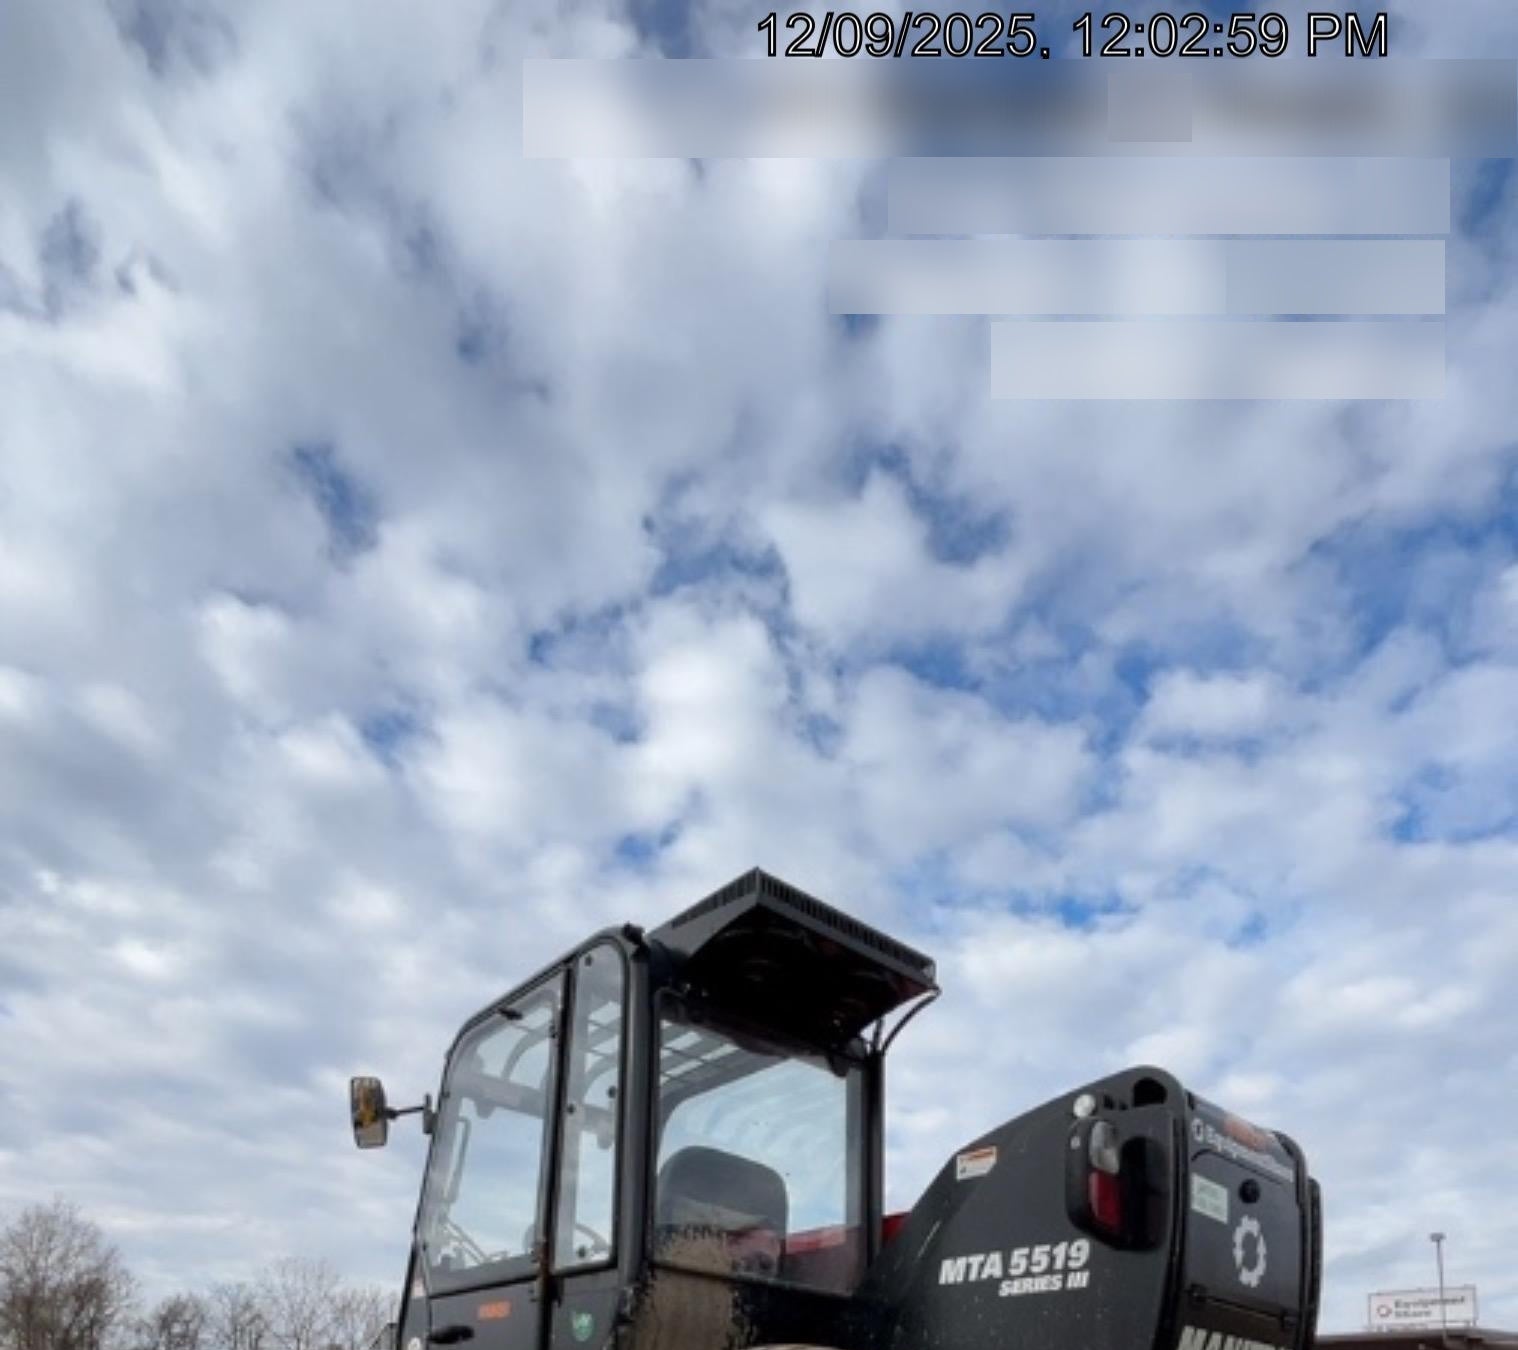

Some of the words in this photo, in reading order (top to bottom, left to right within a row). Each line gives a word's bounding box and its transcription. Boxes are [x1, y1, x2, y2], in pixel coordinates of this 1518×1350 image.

[938, 1251, 1004, 1286] MTA
[1007, 1237, 1091, 1276] 5519
[998, 1273, 1064, 1298] SERIES
